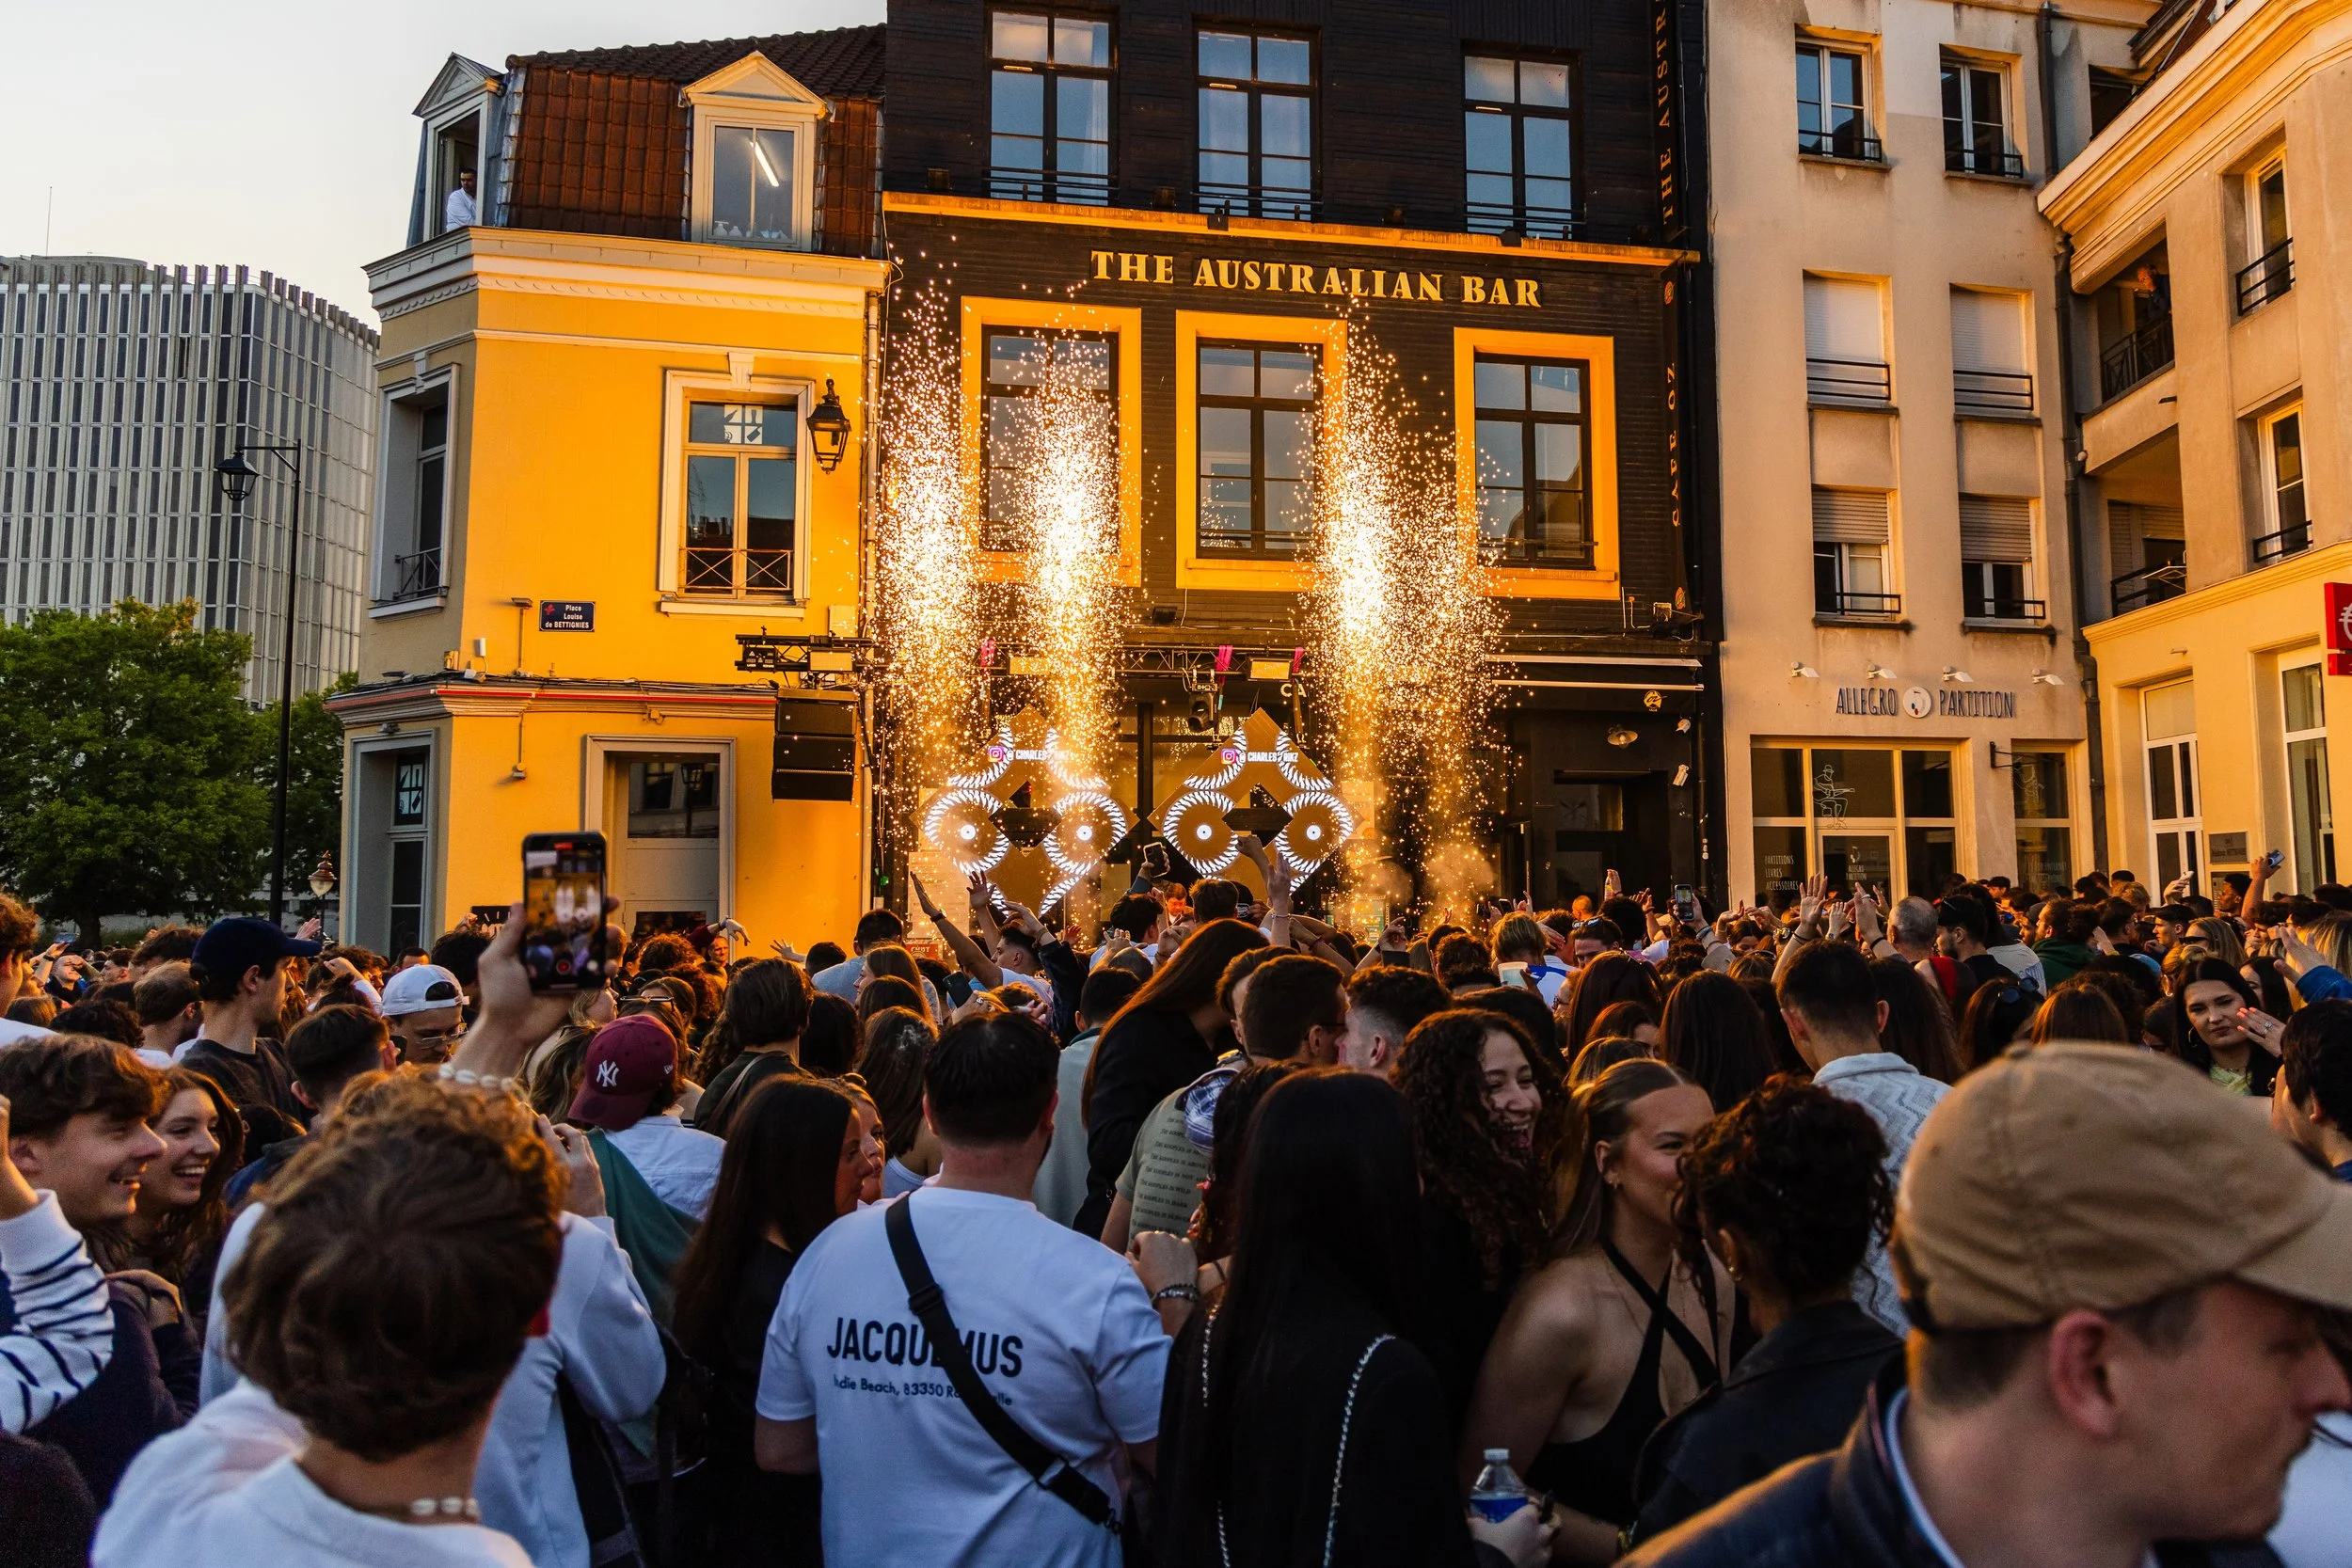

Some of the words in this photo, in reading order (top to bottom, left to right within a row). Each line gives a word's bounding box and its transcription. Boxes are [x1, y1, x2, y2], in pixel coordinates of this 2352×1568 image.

[1656, 0, 1671, 128] AUSTR
[1661, 147, 1674, 225] THE
[1090, 250, 1173, 284] THE
[1194, 259, 1443, 302] AUSTRALIAN
[1461, 276, 1542, 309] BAR
[1836, 688, 1898, 716] ALLEGRO
[1939, 689, 2013, 718] PARTITION
[1248, 752, 1277, 763] CHARLES
[1765, 855, 1794, 865] PARTITIONS
[1766, 868, 1783, 878] LIVRES
[1767, 880, 1799, 891] ACCESSOIRES
[596, 1059, 619, 1087] NY
[861, 1377, 900, 1396] Beach,
[903, 1382, 944, 1398] 83350
